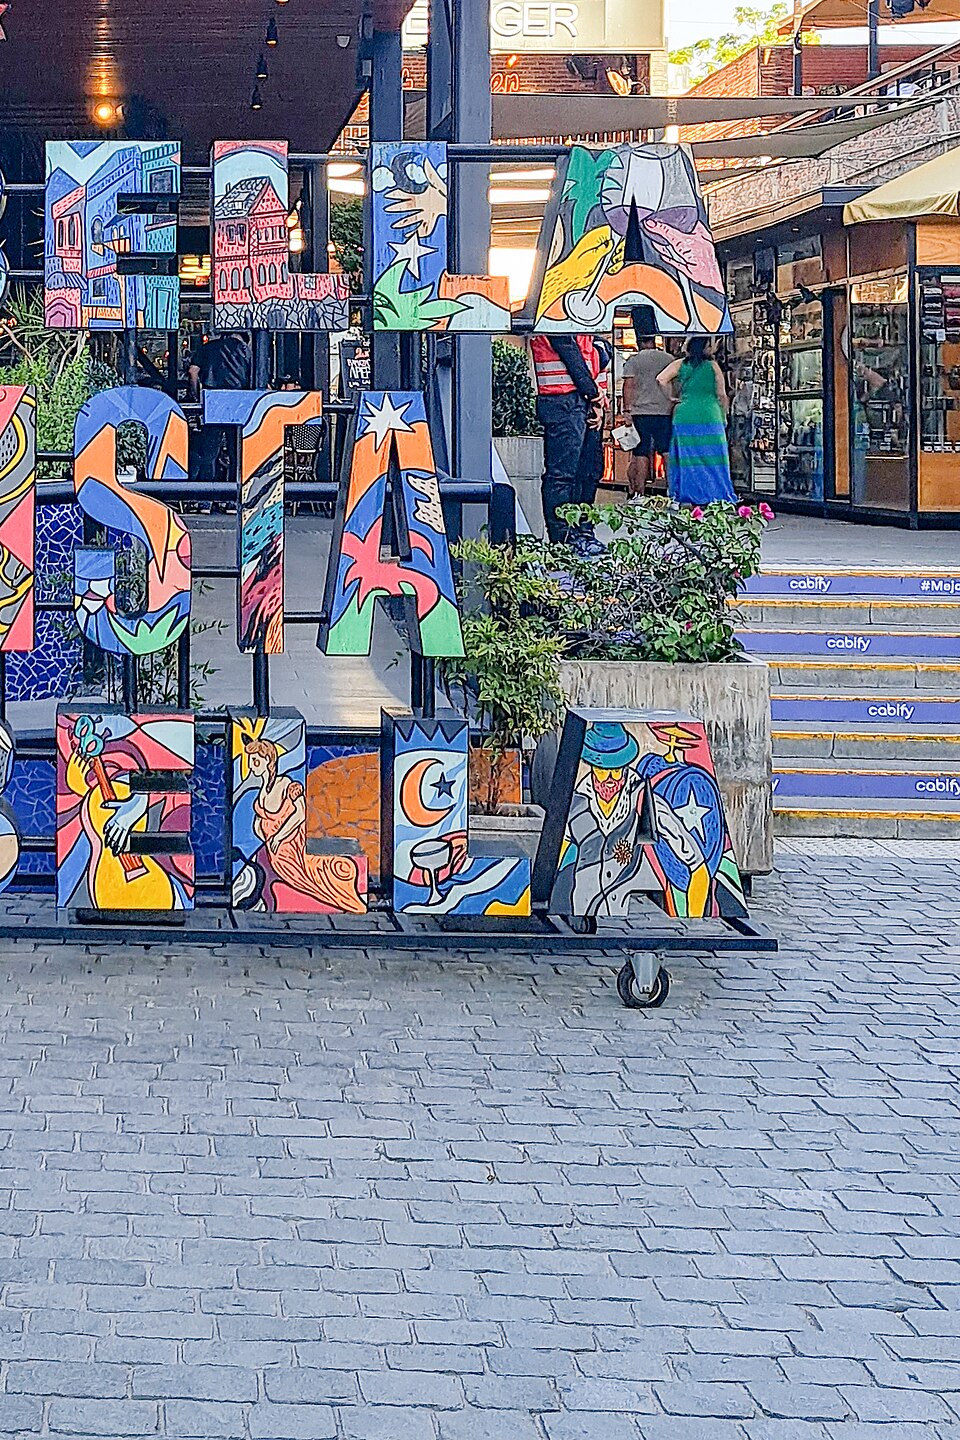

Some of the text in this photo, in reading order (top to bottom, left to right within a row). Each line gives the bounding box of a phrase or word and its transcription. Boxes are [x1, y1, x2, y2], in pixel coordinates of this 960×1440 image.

[789, 576, 832, 592] cabify
[827, 636, 871, 652] cabify
[868, 703, 915, 719] cabify
